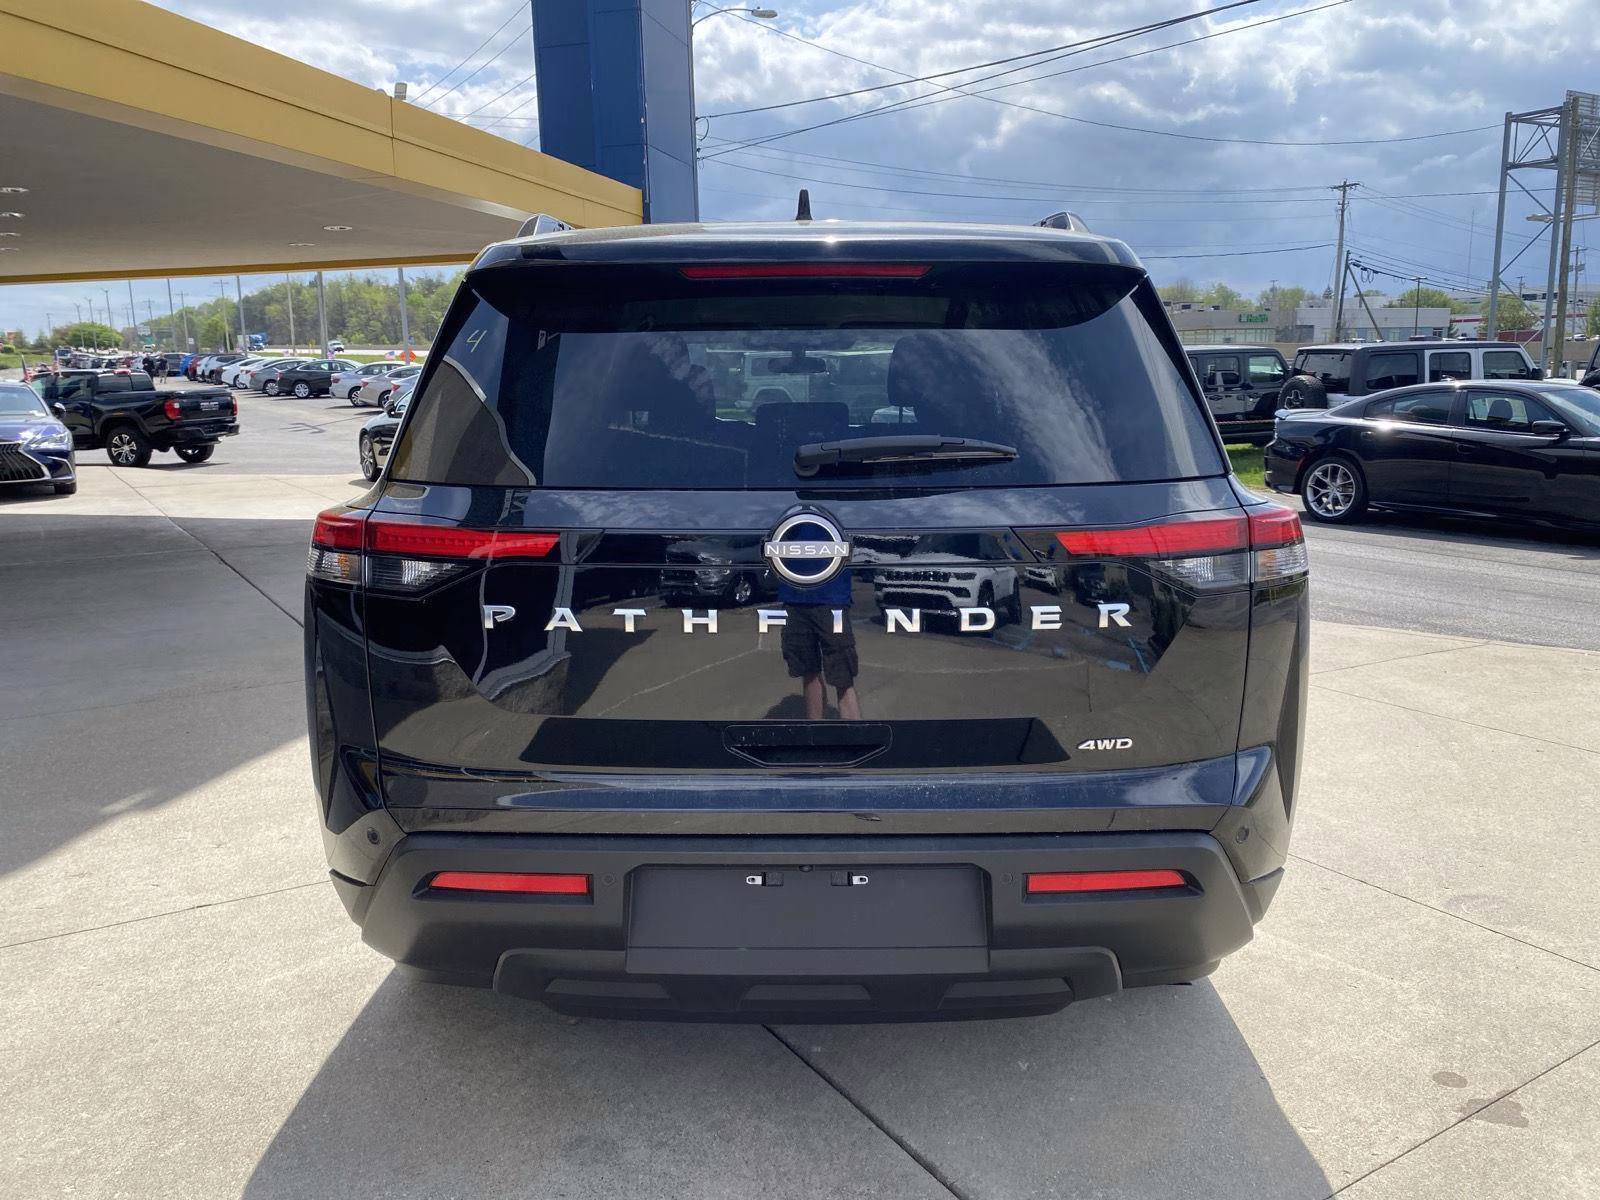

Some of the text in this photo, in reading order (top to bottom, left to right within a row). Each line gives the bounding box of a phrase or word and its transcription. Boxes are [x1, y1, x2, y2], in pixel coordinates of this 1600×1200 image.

[466, 329, 488, 353] 4
[766, 544, 847, 555] NISSAN
[482, 602, 1132, 634] PATHFINDER
[1078, 737, 1133, 750] 4WD
